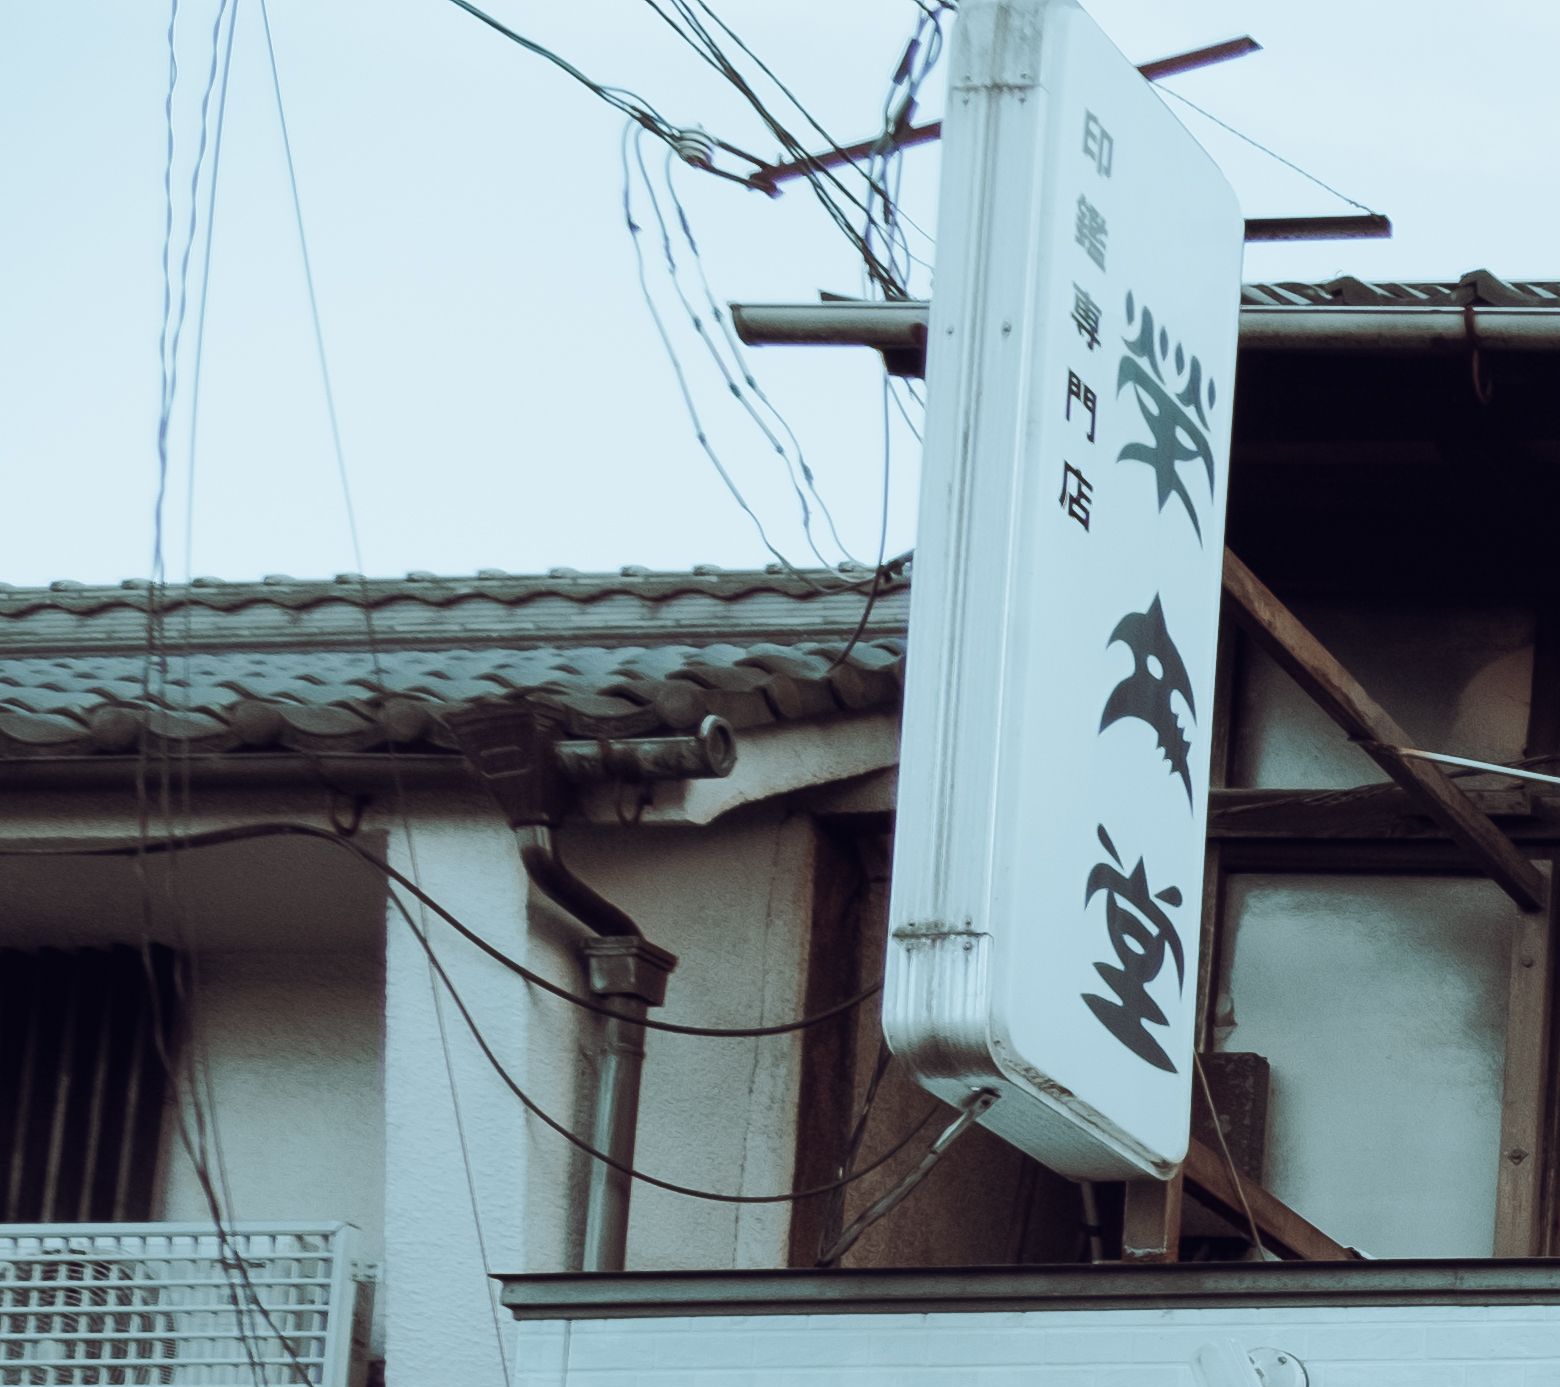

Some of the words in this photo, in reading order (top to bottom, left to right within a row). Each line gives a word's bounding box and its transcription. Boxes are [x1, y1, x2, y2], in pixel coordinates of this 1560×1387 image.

[1060, 108, 1114, 534] 印鑑専門店
